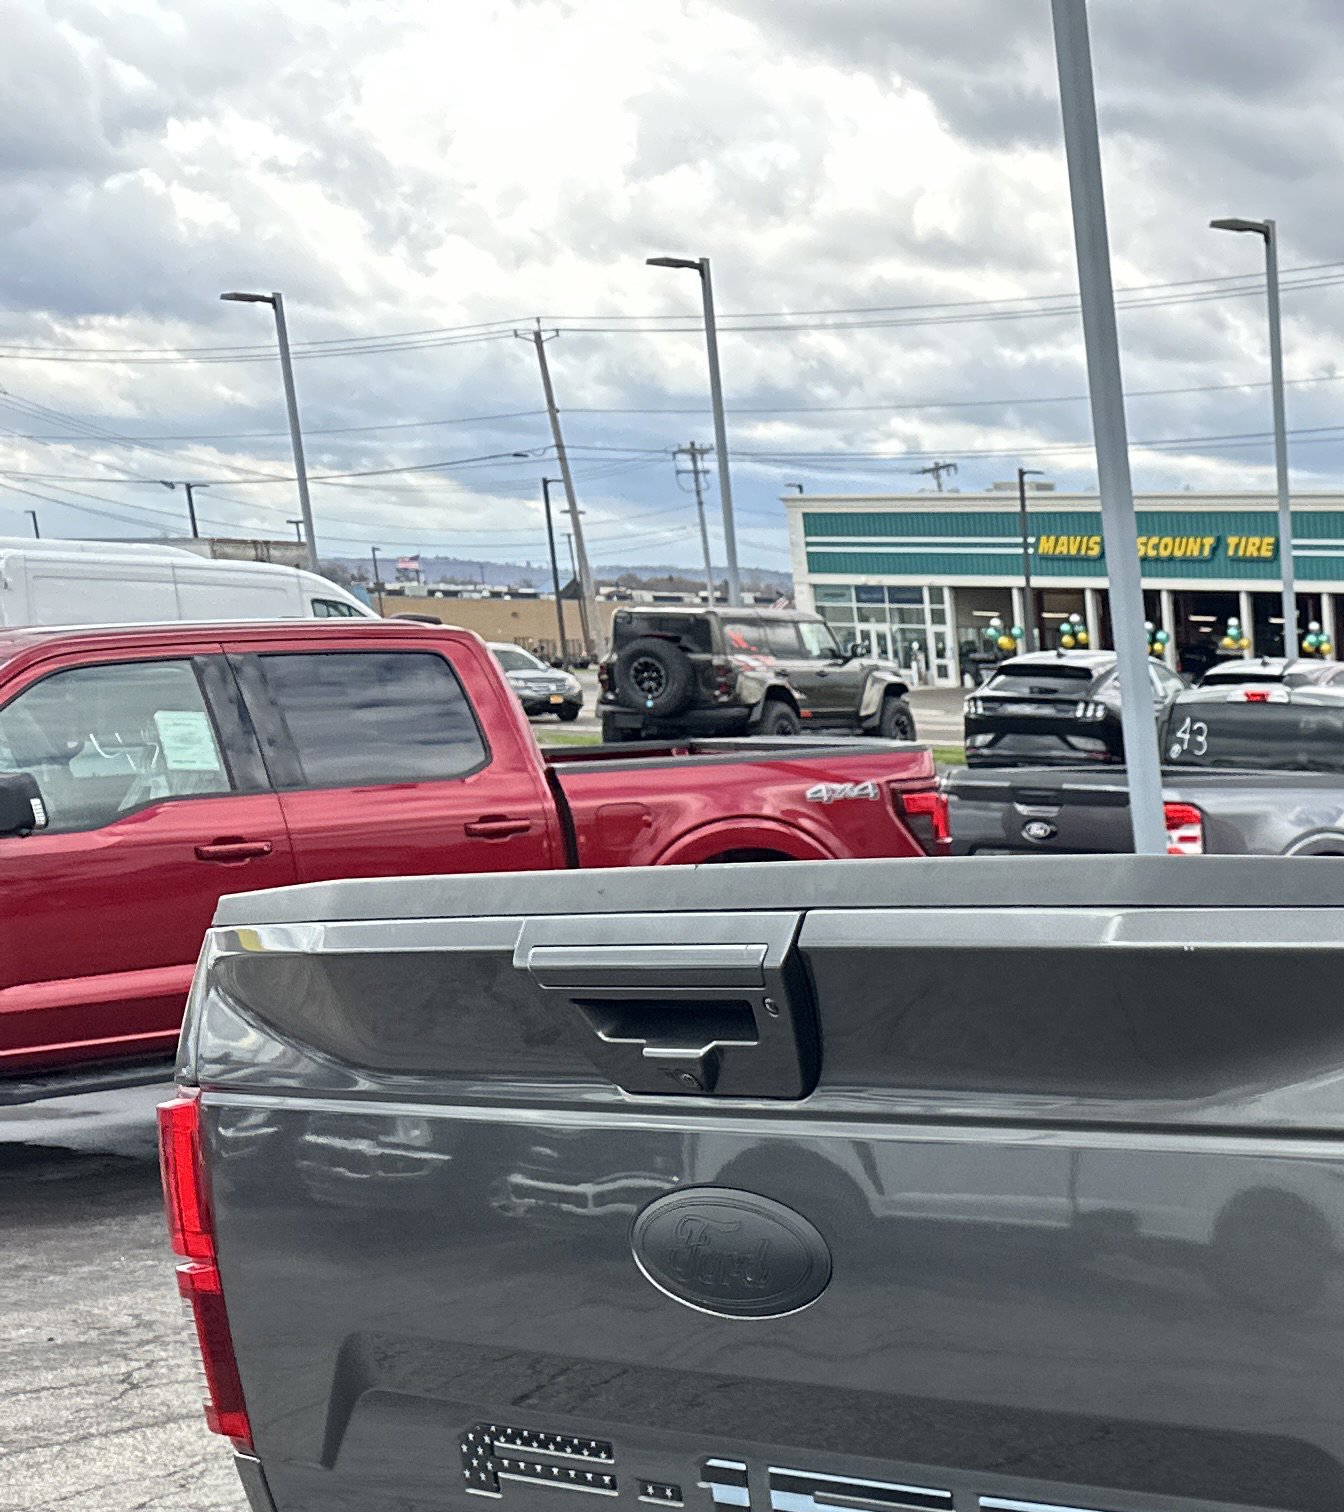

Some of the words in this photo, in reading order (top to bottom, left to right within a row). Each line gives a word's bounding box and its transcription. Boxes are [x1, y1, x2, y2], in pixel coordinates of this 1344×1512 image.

[1038, 534, 1102, 556] MAVIS
[1135, 535, 1216, 559] SCOUNT
[1226, 535, 1276, 557] TIRE
